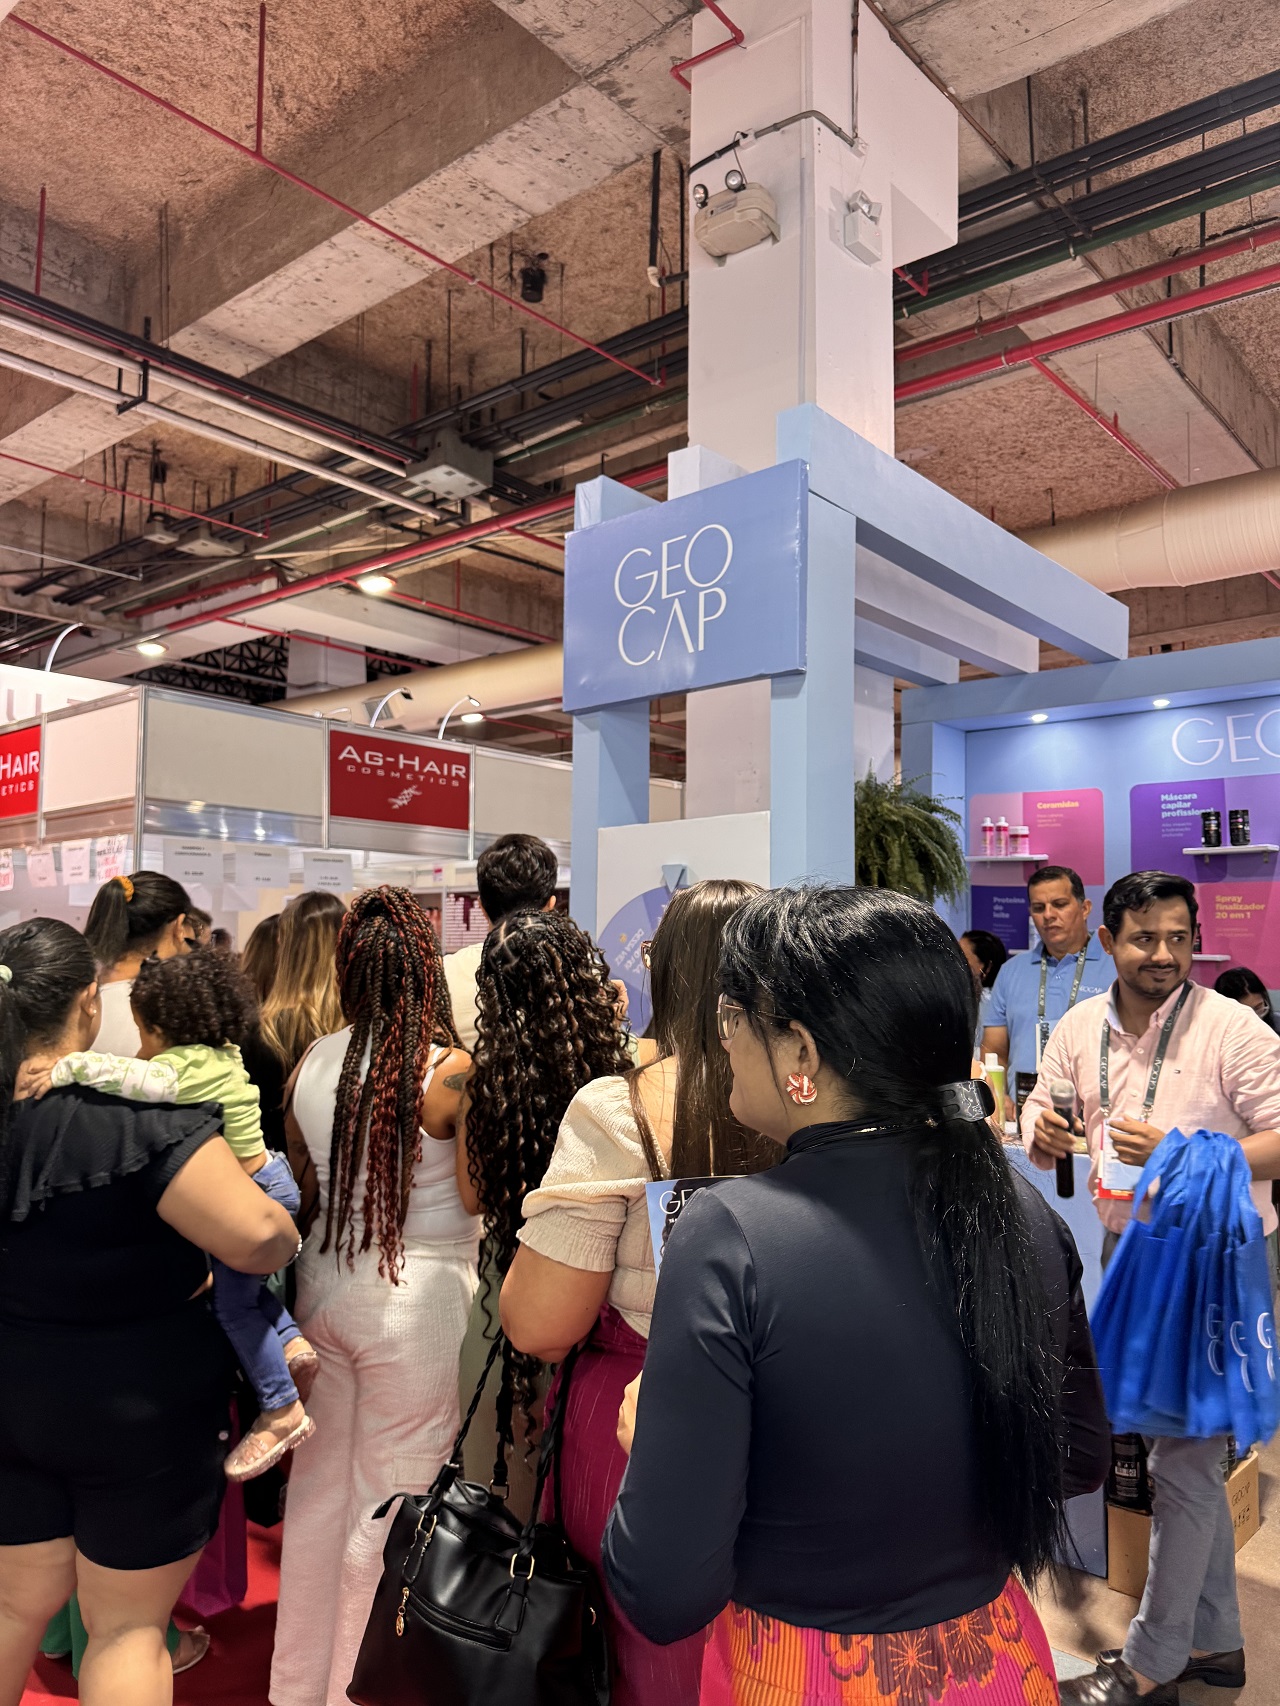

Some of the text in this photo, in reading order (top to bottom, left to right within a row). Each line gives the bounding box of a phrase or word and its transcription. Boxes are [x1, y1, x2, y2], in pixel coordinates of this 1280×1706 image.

[614, 523, 733, 608] GEO
[618, 587, 727, 666] CAP
[337, 744, 467, 779] AG-HAIR
[346, 764, 459, 787] COSMETICS
[1036, 800, 1079, 809] Ceramidas
[1161, 792, 1198, 802] Máscara
[1161, 801, 1192, 810] capilar
[1215, 895, 1243, 903] Spray
[1215, 903, 1266, 911] finalizador
[1215, 911, 1228, 919] 20
[1246, 911, 1251, 919] 1
[1100, 1056, 1109, 1089] GEOCAP
[1148, 1056, 1162, 1090] GEOCAP
